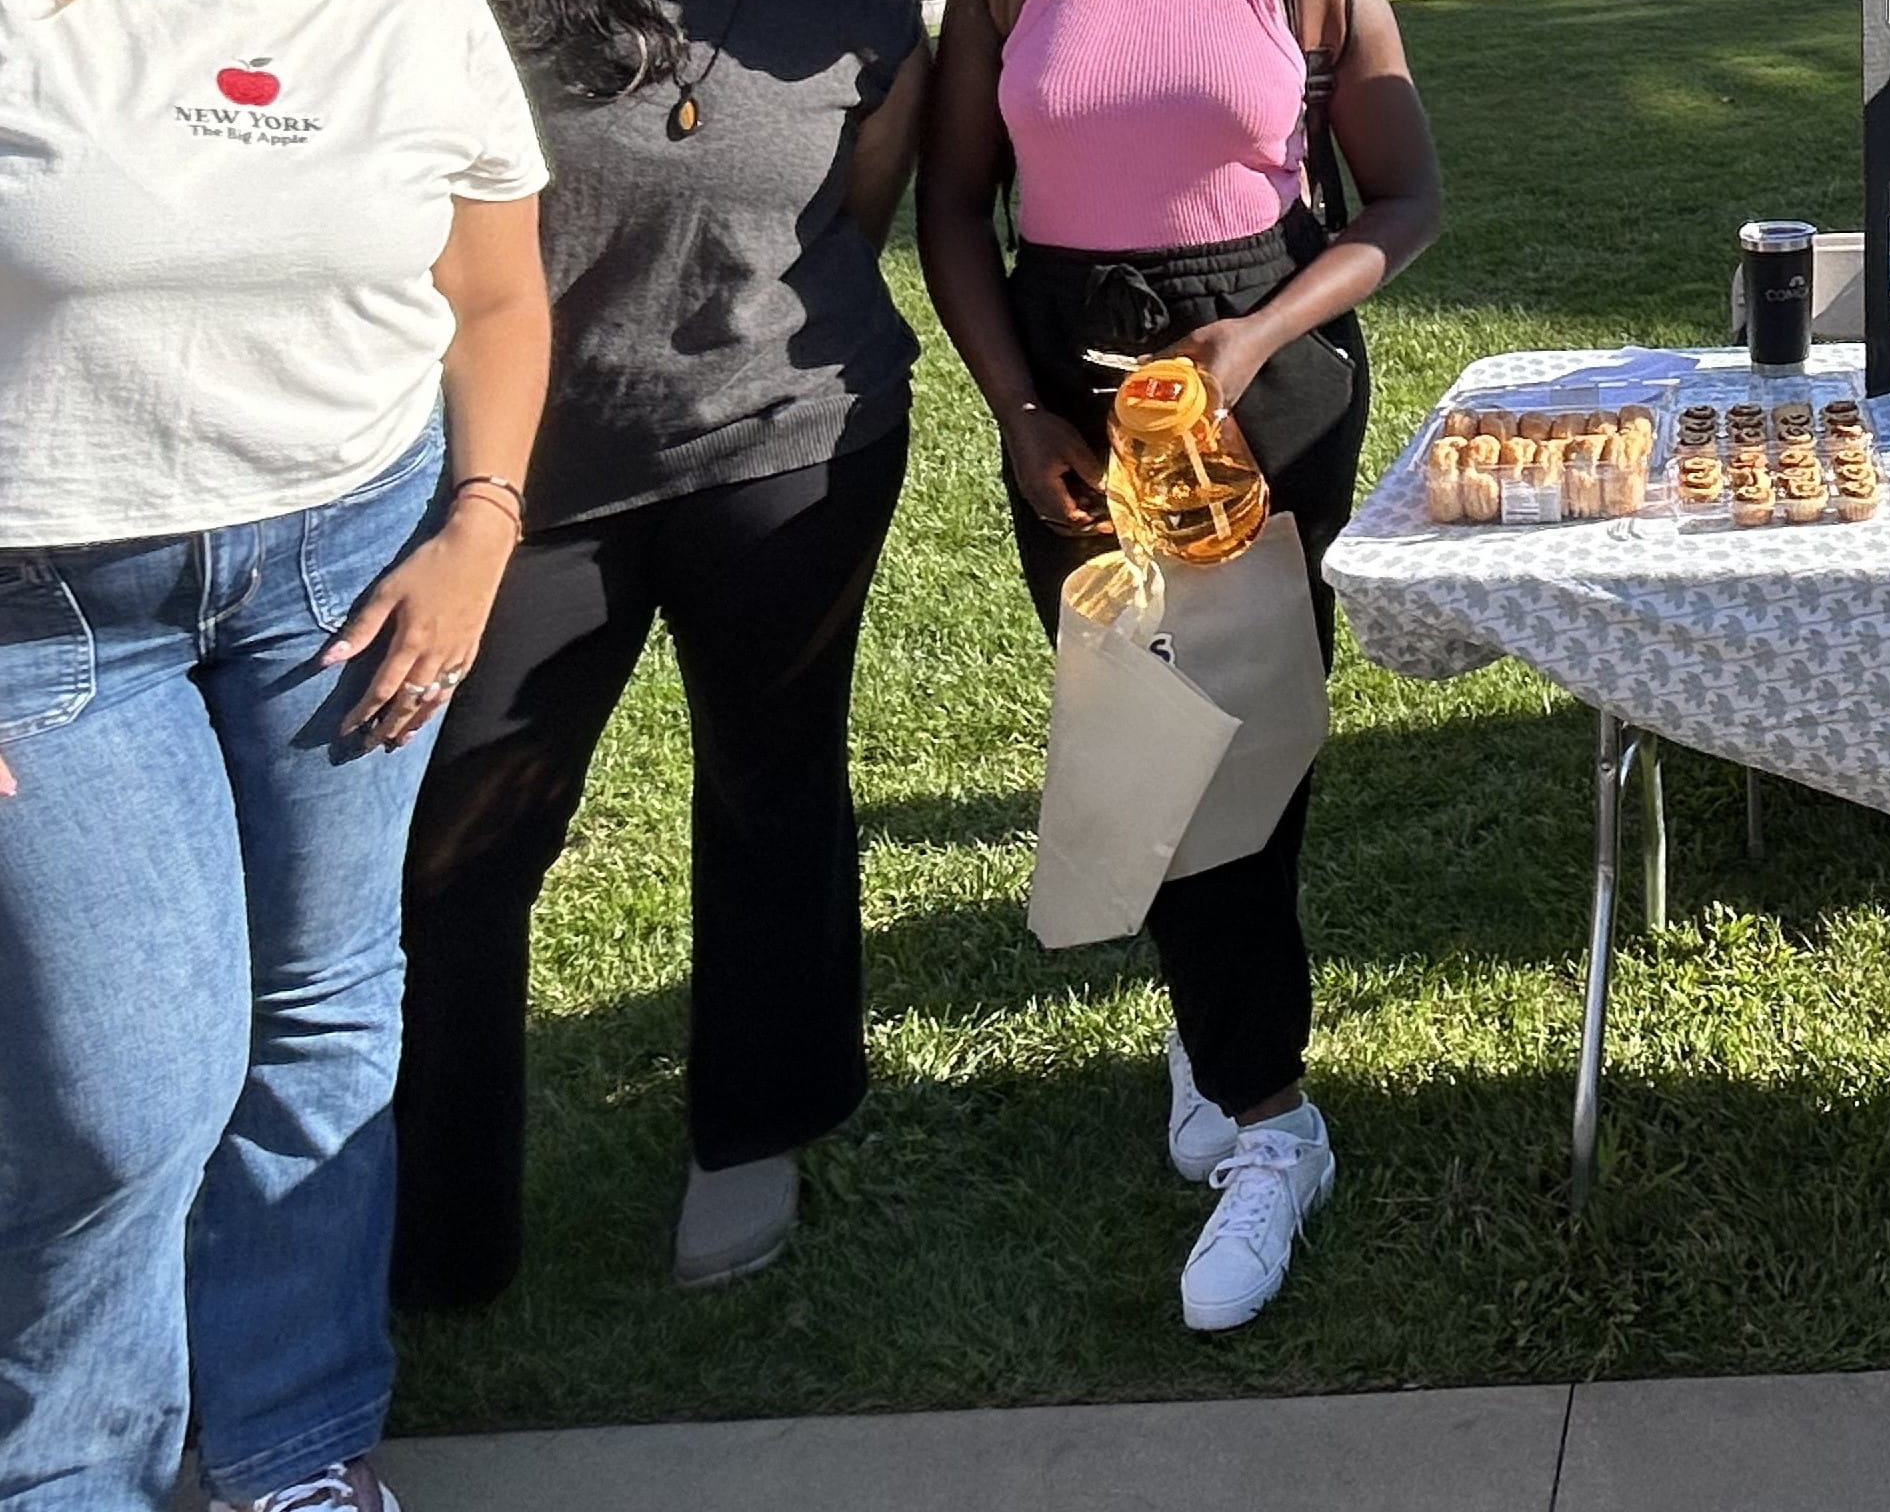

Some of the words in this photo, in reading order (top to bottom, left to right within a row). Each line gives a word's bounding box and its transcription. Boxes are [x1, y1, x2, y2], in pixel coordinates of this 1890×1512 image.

[174, 105, 240, 124] NEW
[248, 111, 323, 132] YORK
[188, 124, 223, 137] The
[227, 127, 253, 145] Big
[257, 132, 308, 147] Apple
